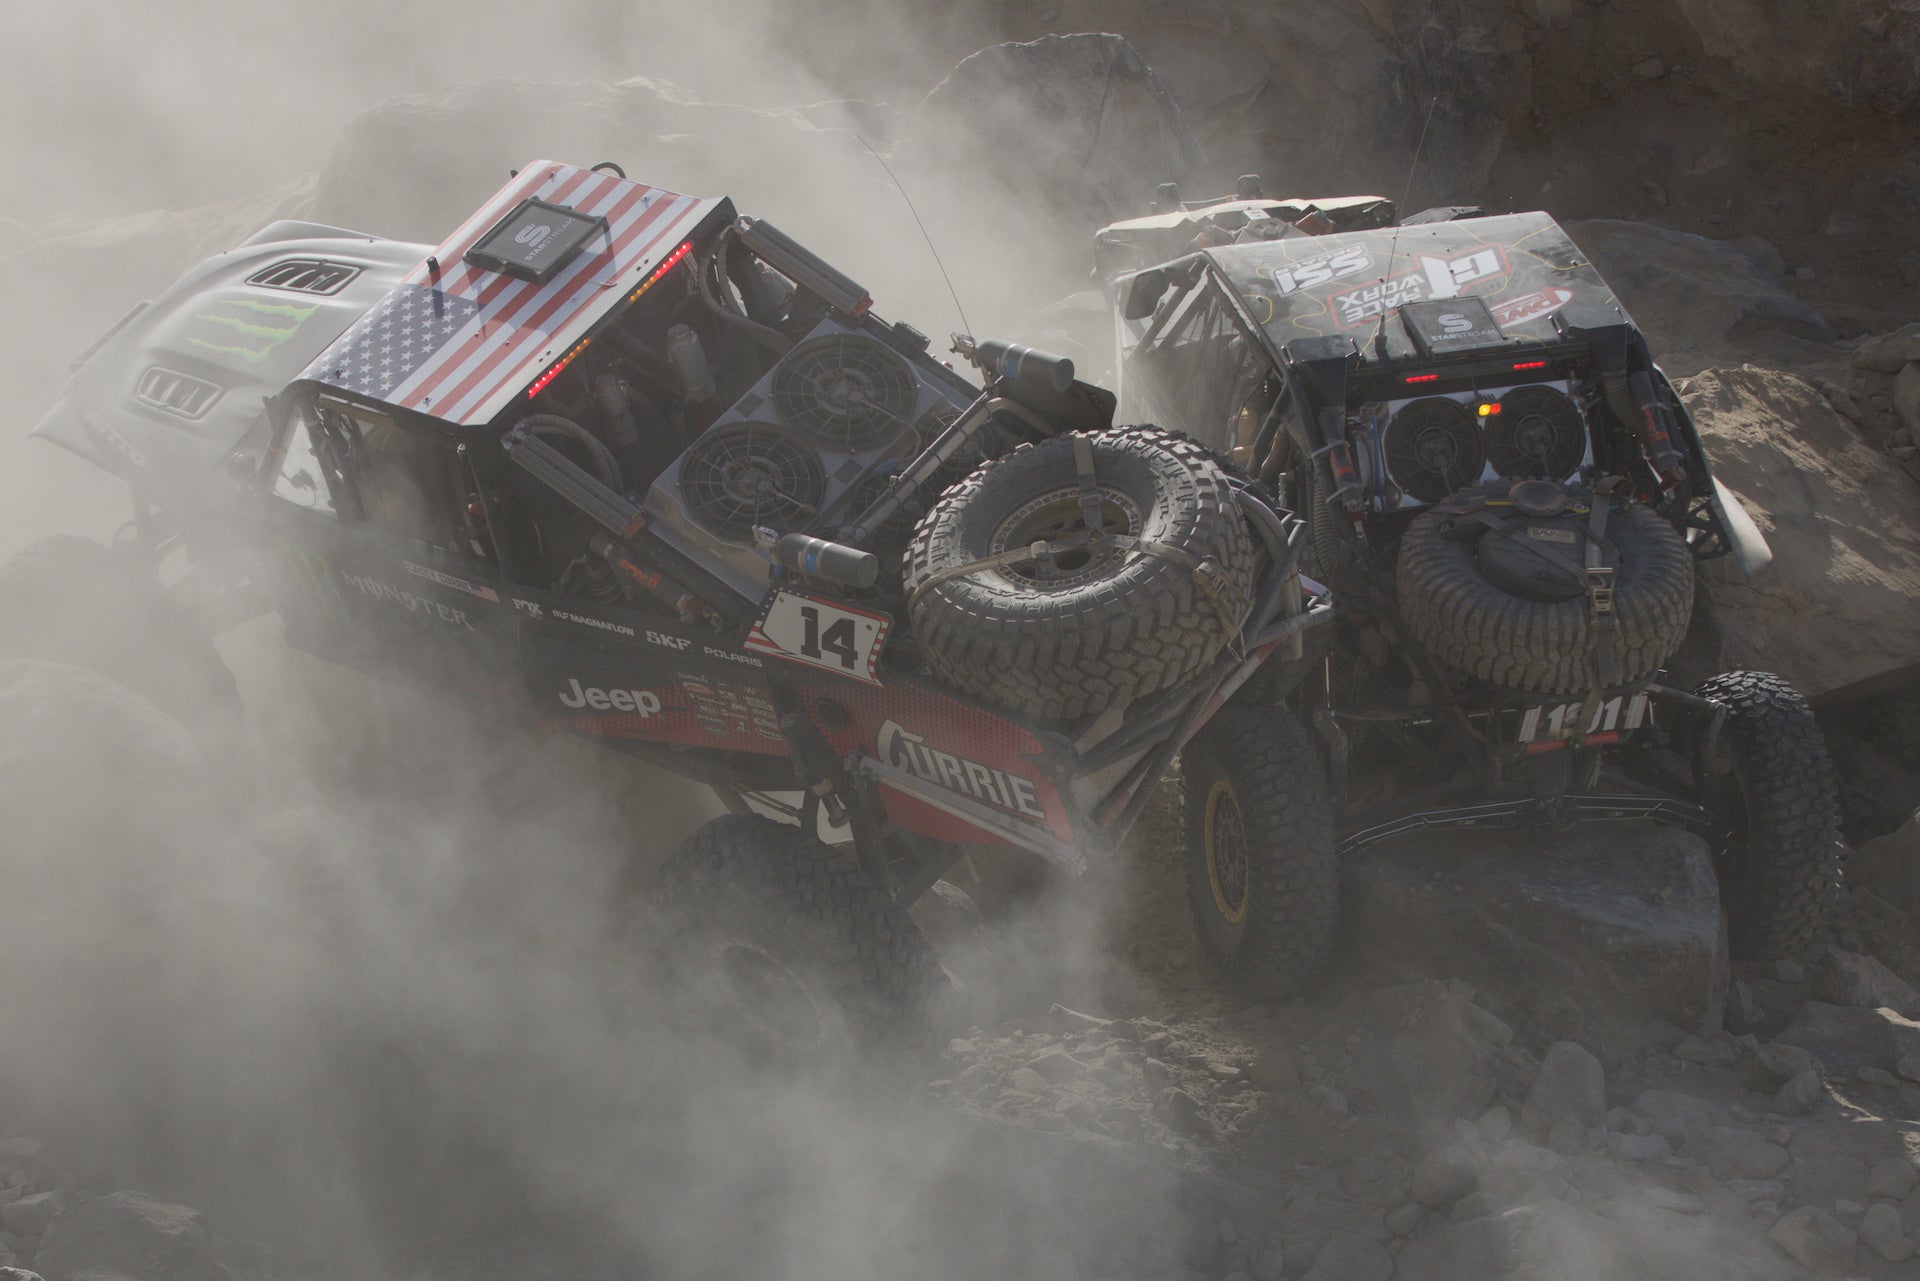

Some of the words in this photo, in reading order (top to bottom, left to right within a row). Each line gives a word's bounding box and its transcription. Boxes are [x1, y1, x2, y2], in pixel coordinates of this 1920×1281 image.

[1336, 274, 1425, 311] WORX
[1344, 285, 1421, 323] RACE
[570, 613, 634, 636] MAGNAFLOW
[645, 630, 692, 652] SKF
[799, 605, 859, 670] 14
[703, 646, 763, 668] POLARIS
[558, 678, 662, 719] Jeep
[876, 719, 1047, 820] CURRIE
